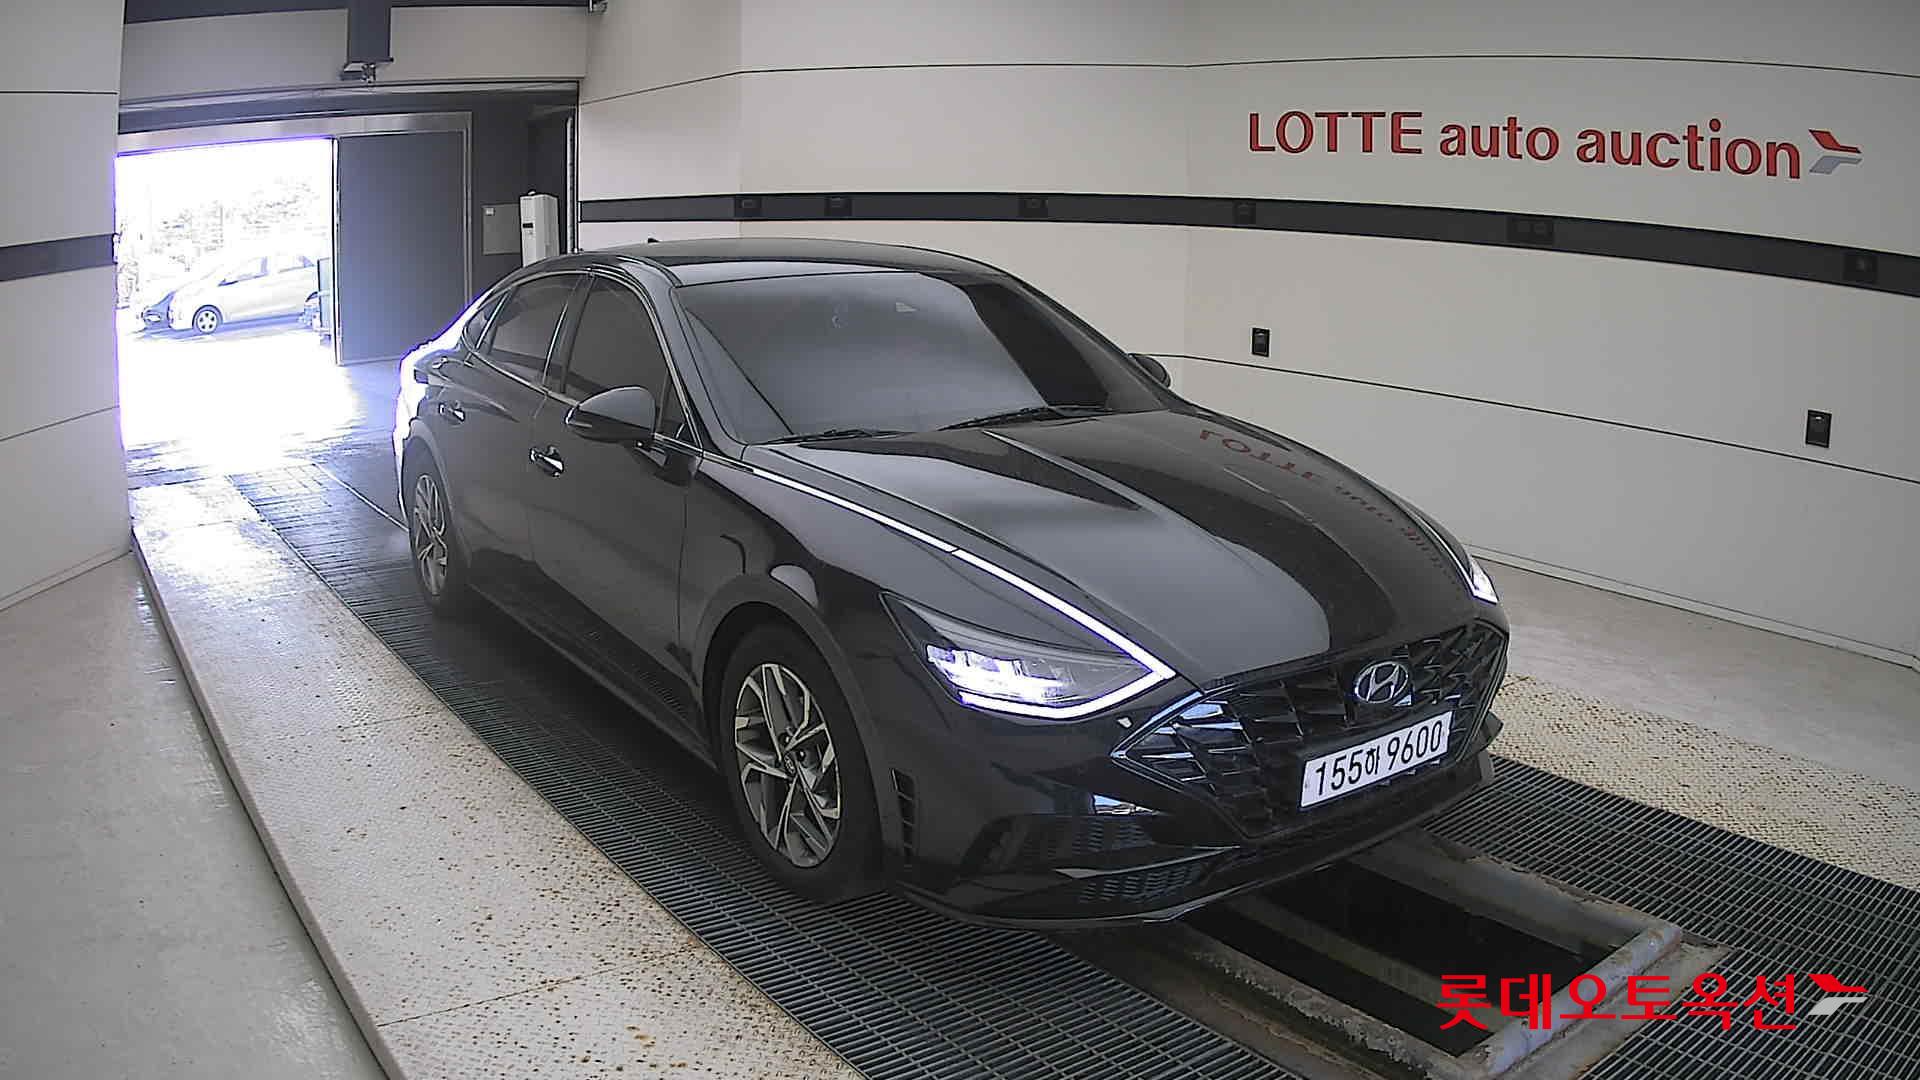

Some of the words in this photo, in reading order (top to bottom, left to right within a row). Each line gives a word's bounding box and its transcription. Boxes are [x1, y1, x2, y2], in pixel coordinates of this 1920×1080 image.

[1249, 111, 1423, 155] LOTTE
[1439, 116, 1560, 161] auto
[1576, 118, 1801, 180] auction
[1387, 720, 1443, 771] 9600
